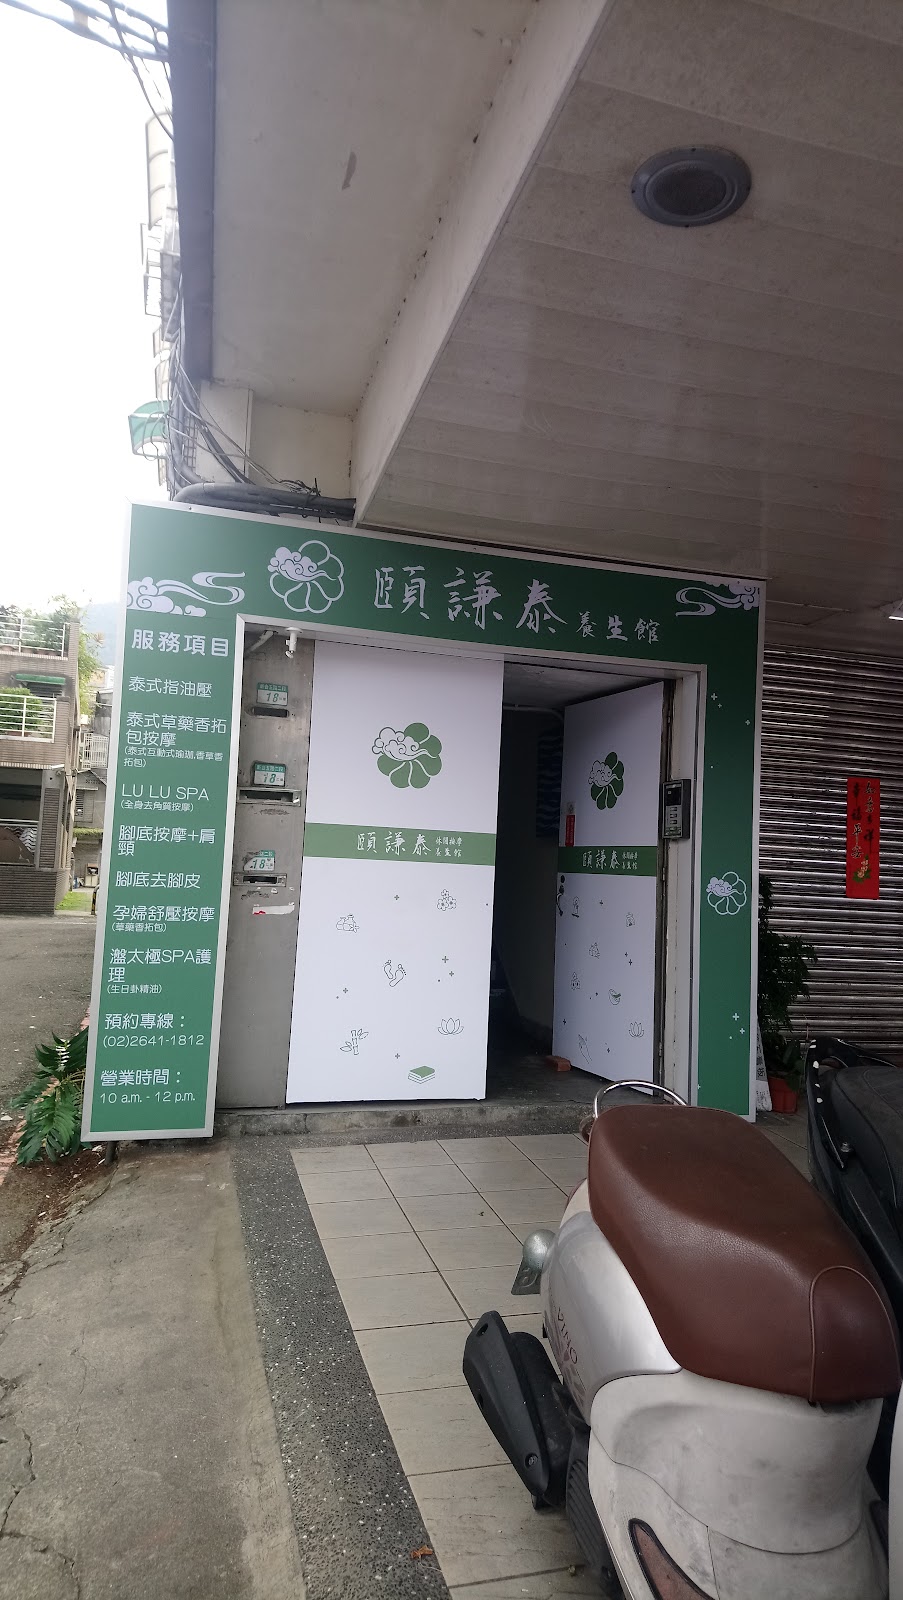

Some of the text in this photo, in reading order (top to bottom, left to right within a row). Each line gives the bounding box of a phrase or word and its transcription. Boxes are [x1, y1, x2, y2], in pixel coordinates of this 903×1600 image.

[131, 628, 229, 657] 服務項目
[128, 676, 212, 698] 泰式指油壓
[126, 711, 227, 734] 泰式草藥香拓
[125, 729, 177, 747] 包按摩
[121, 783, 210, 801] LU LU SPA
[118, 824, 216, 844] 腳底按摩+肩
[117, 840, 135, 857] 頸
[115, 870, 201, 889] 腳底去腳皮
[113, 905, 215, 923] 孕婦舒壓按摩
[107, 966, 126, 983] 理
[102, 1034, 205, 1048] (02)2641-1812
[100, 1092, 117, 1104] 10
[121, 1092, 142, 1104] a.m.
[154, 1091, 171, 1102] 12
[174, 1091, 196, 1103] p.m.
